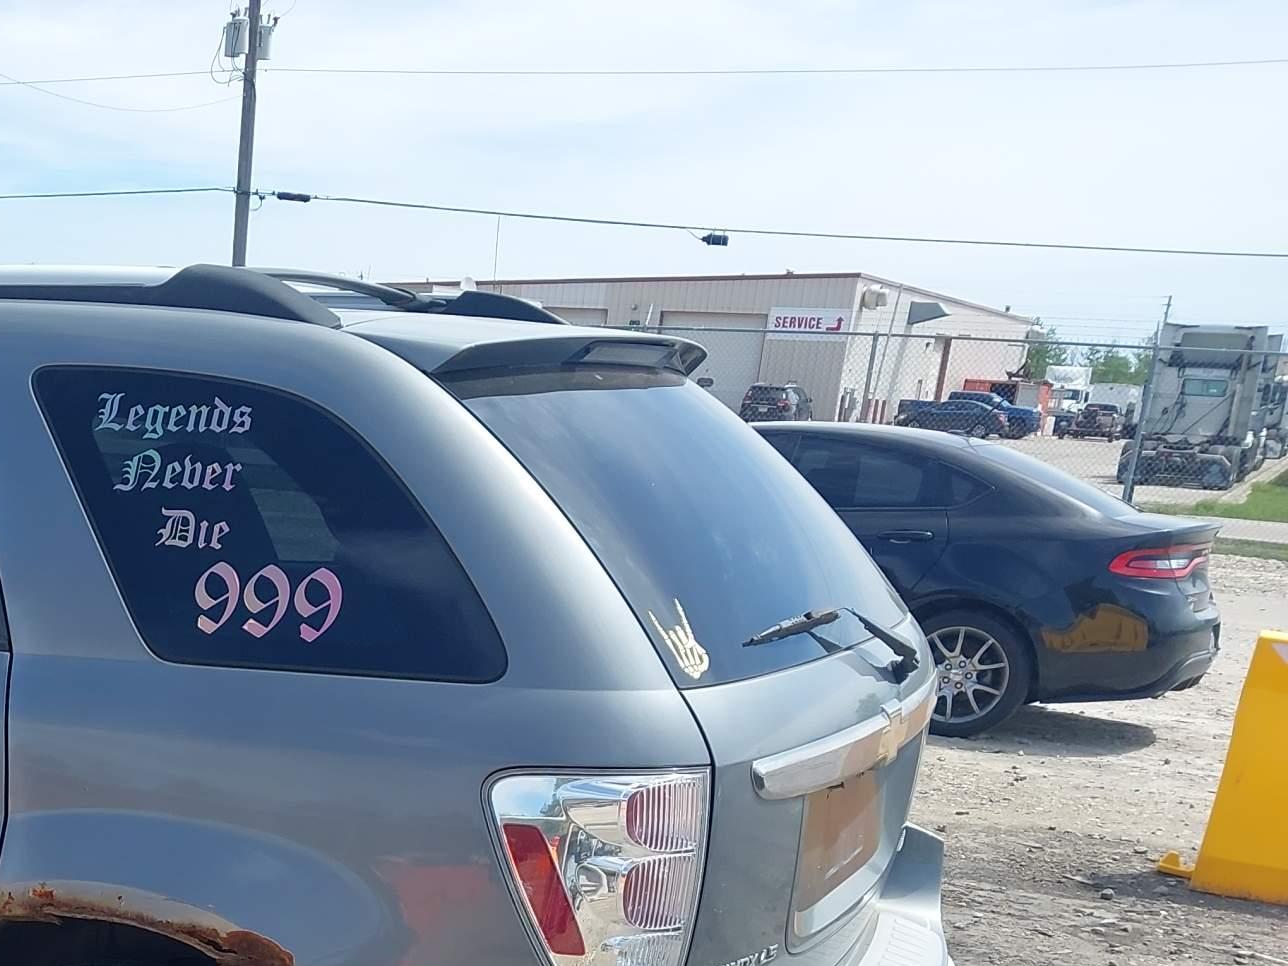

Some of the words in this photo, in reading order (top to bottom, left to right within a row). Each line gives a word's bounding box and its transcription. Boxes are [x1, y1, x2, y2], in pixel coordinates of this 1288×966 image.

[774, 316, 823, 330] SERVICE
[94, 392, 252, 440] Legends
[113, 448, 244, 492] Never
[155, 506, 231, 549] Die
[194, 561, 343, 643] 999
